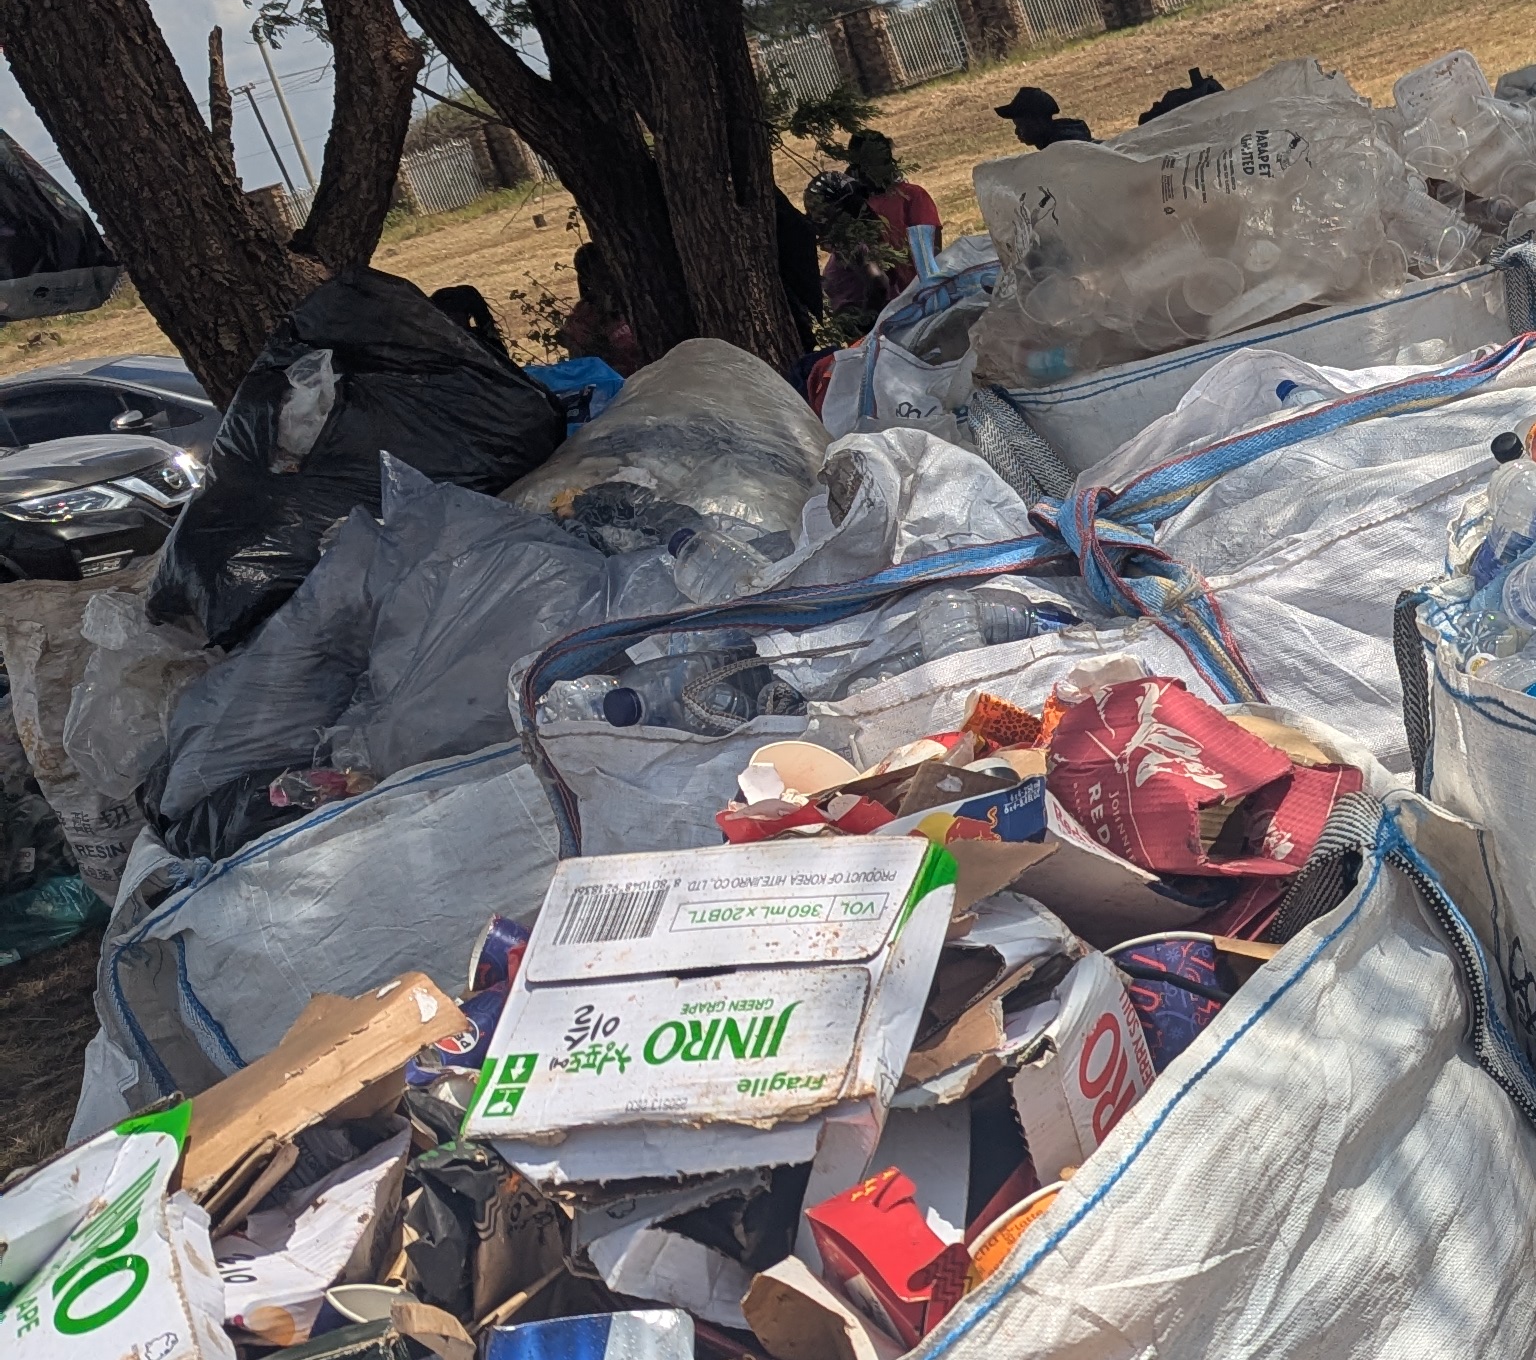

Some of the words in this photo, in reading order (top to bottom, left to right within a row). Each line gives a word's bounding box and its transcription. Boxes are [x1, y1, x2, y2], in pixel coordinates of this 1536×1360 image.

[1252, 129, 1271, 180] PARAPET
[1088, 781, 1111, 844] RED
[75, 842, 128, 860] RESIN
[790, 872, 828, 886] KOREA
[829, 872, 844, 884] OF
[843, 868, 898, 886] PRODUCT
[840, 901, 876, 916] VOL
[680, 1000, 726, 1016] GRAPE
[728, 998, 775, 1012] GREEN
[643, 999, 804, 1066] JINRO
[737, 1071, 827, 1097] Fragile
[15, 1296, 41, 1340] APE
